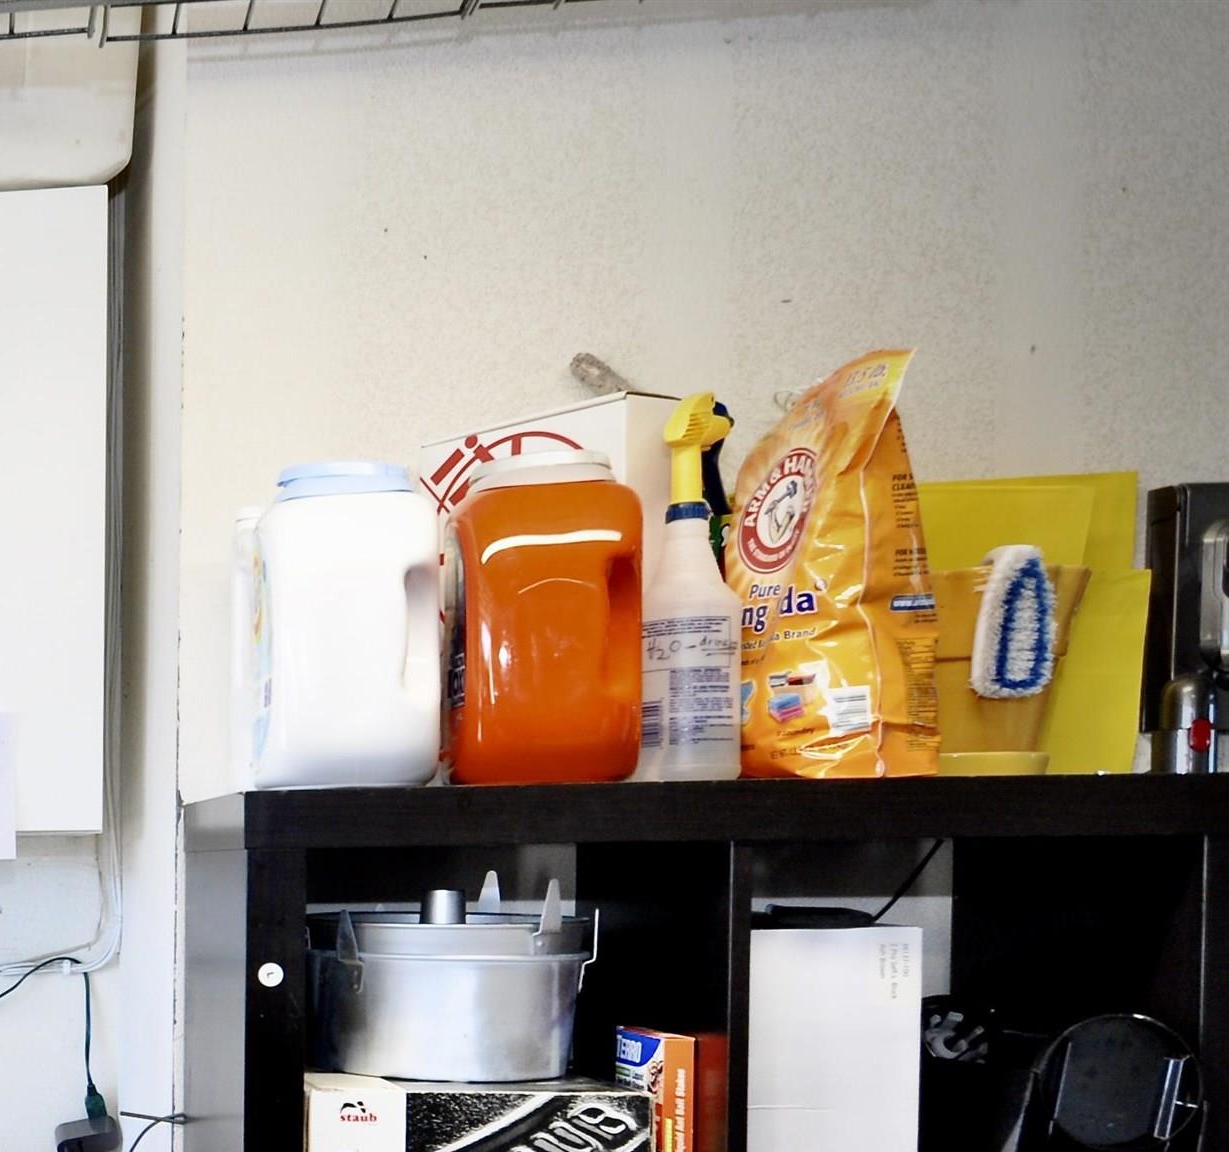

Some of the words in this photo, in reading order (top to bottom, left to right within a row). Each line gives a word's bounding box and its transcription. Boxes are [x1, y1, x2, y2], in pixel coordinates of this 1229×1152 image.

[744, 486, 772, 528] ARM
[749, 583, 781, 599] Pure
[784, 627, 817, 640] Brand
[616, 1033, 643, 1064] TERRO
[339, 1113, 377, 1122] staub
